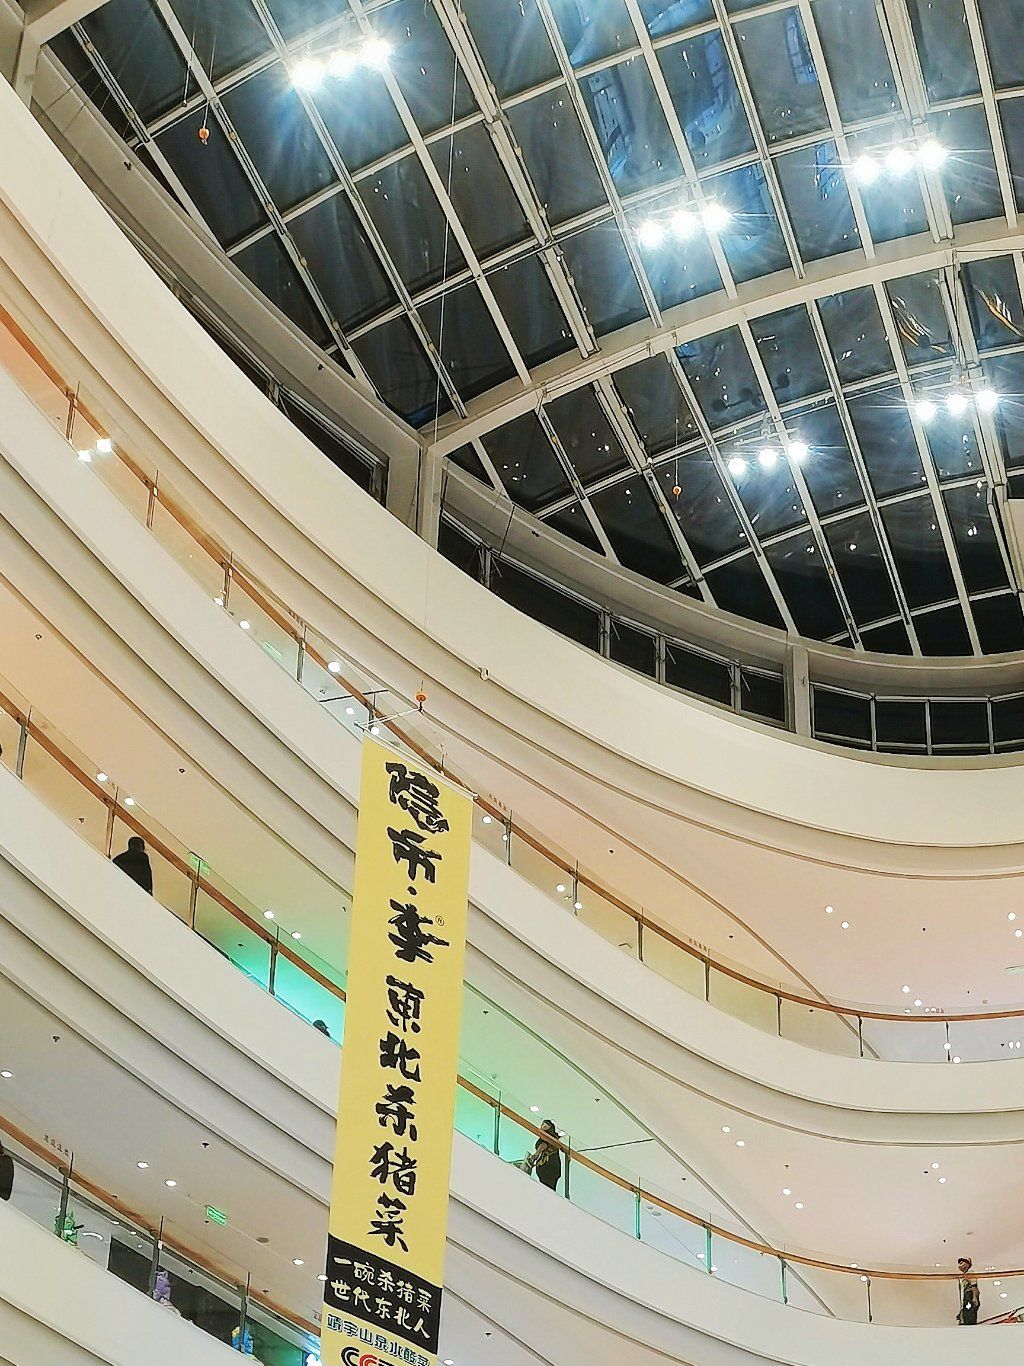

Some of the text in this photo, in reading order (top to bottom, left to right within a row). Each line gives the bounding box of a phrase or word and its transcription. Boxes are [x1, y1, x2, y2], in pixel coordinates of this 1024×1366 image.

[330, 1279, 431, 1340] 世代东北人
[333, 1256, 432, 1314] 一碗杀猪菜
